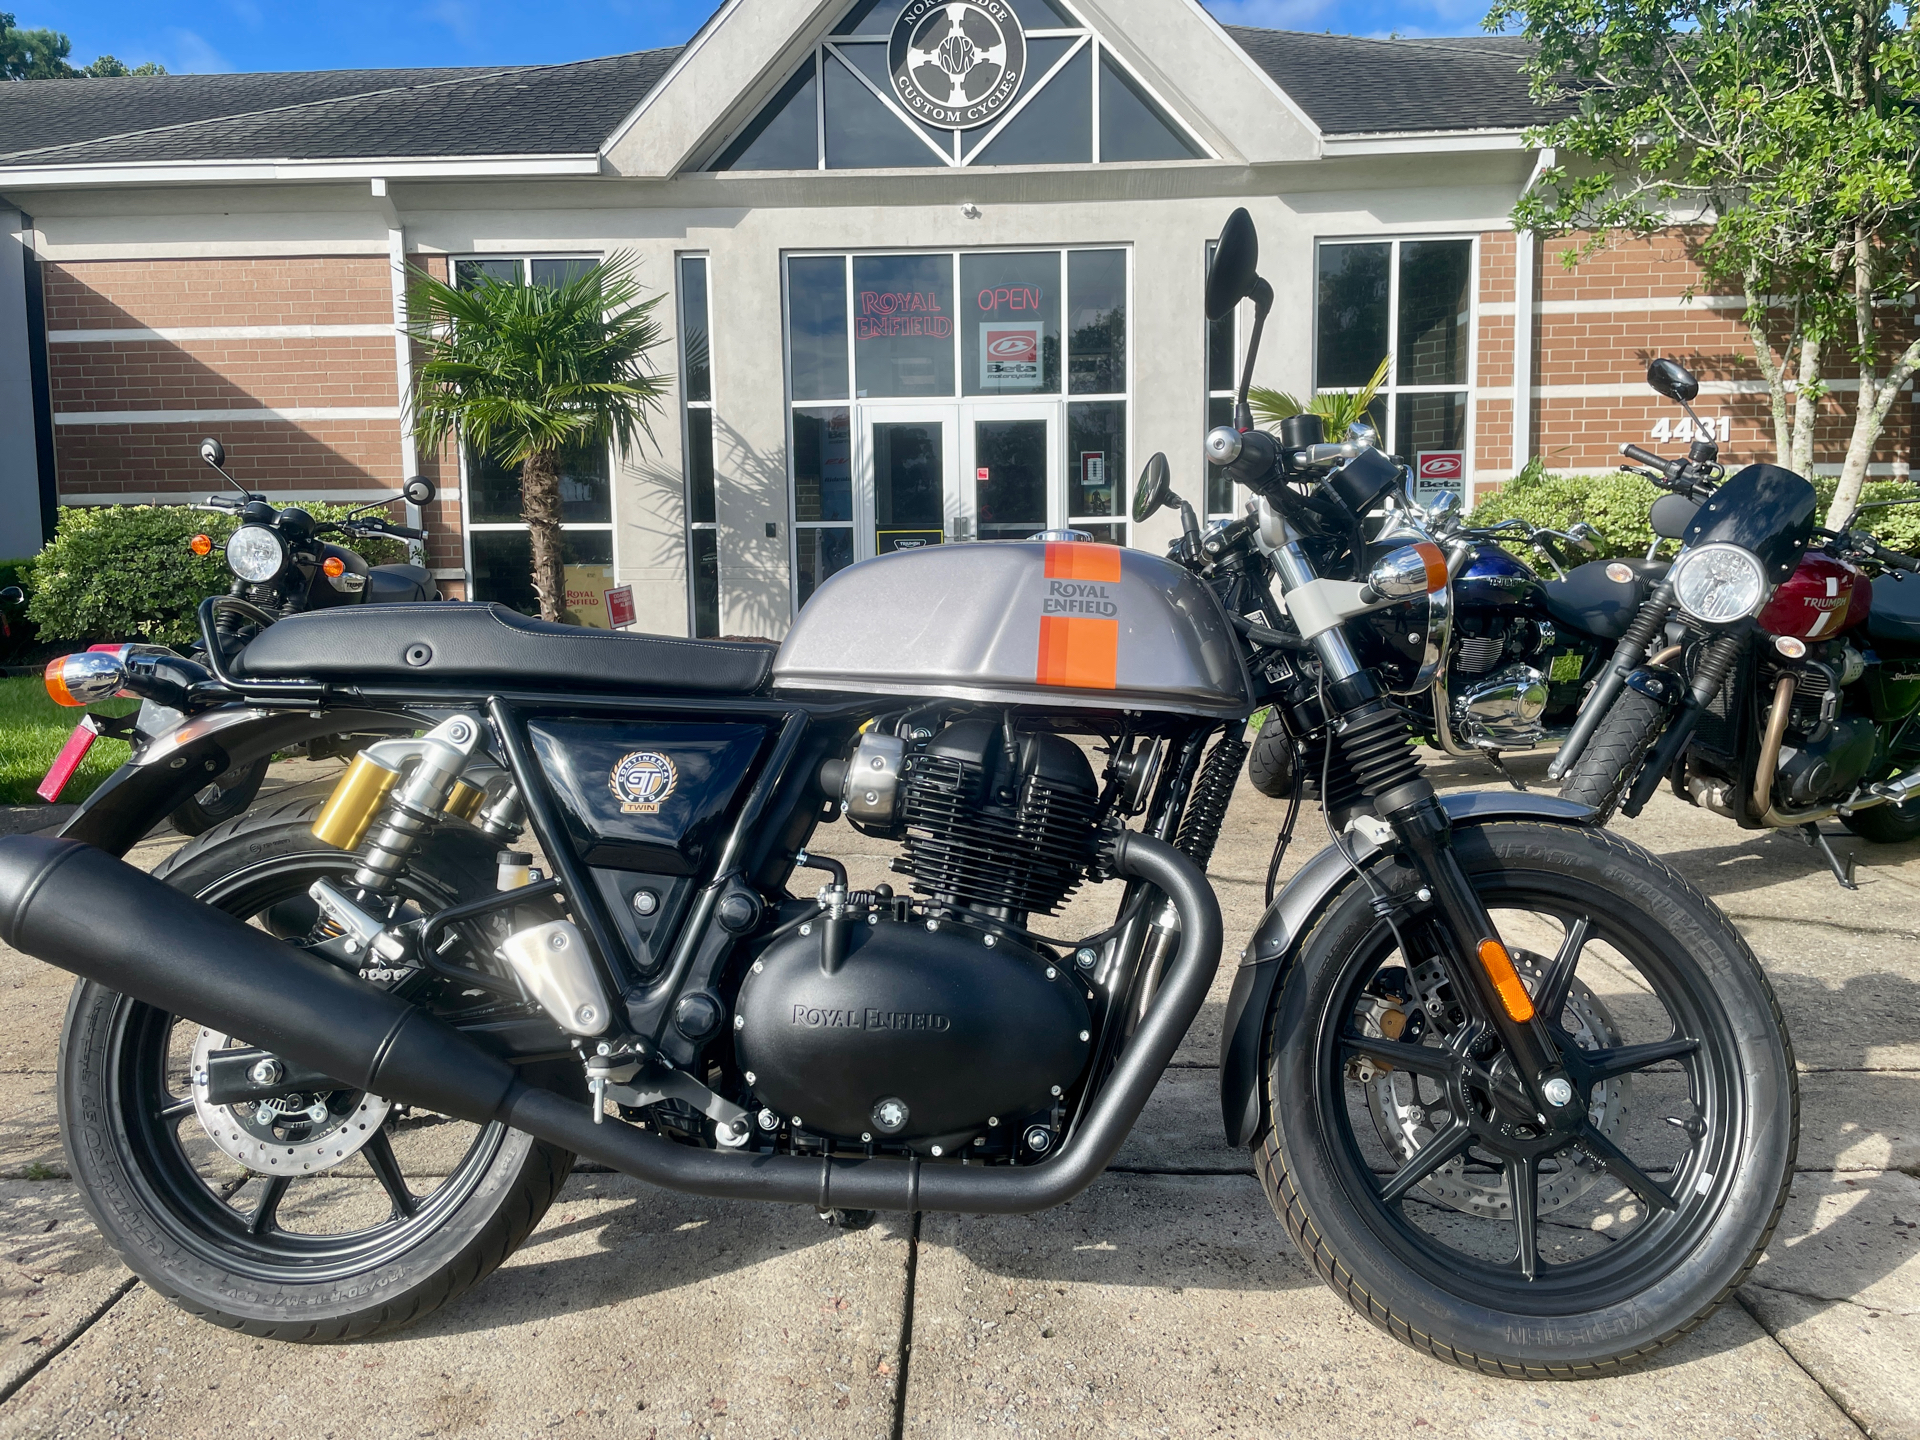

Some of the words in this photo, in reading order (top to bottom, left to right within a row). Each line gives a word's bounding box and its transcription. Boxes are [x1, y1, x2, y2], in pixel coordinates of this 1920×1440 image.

[898, 75, 961, 121] CUSTOM
[967, 70, 1017, 119] CYCLES
[860, 291, 941, 315] ROYAL
[978, 288, 1039, 311] OPEN
[856, 317, 953, 340] ENFIELD
[987, 363, 1037, 373] Beta
[1651, 416, 1730, 443] 4481
[566, 590, 595, 598] ROYAL
[1049, 581, 1109, 598] ROYAL
[565, 598, 599, 608] ENFIELD
[1043, 598, 1117, 617] ENFIELD
[1803, 597, 1847, 611] TRIUMPH
[618, 756, 669, 784] CONTINENTAL
[627, 768, 662, 796] GT
[793, 1004, 860, 1028] ROYAL
[864, 1008, 950, 1032] ENFIELD
